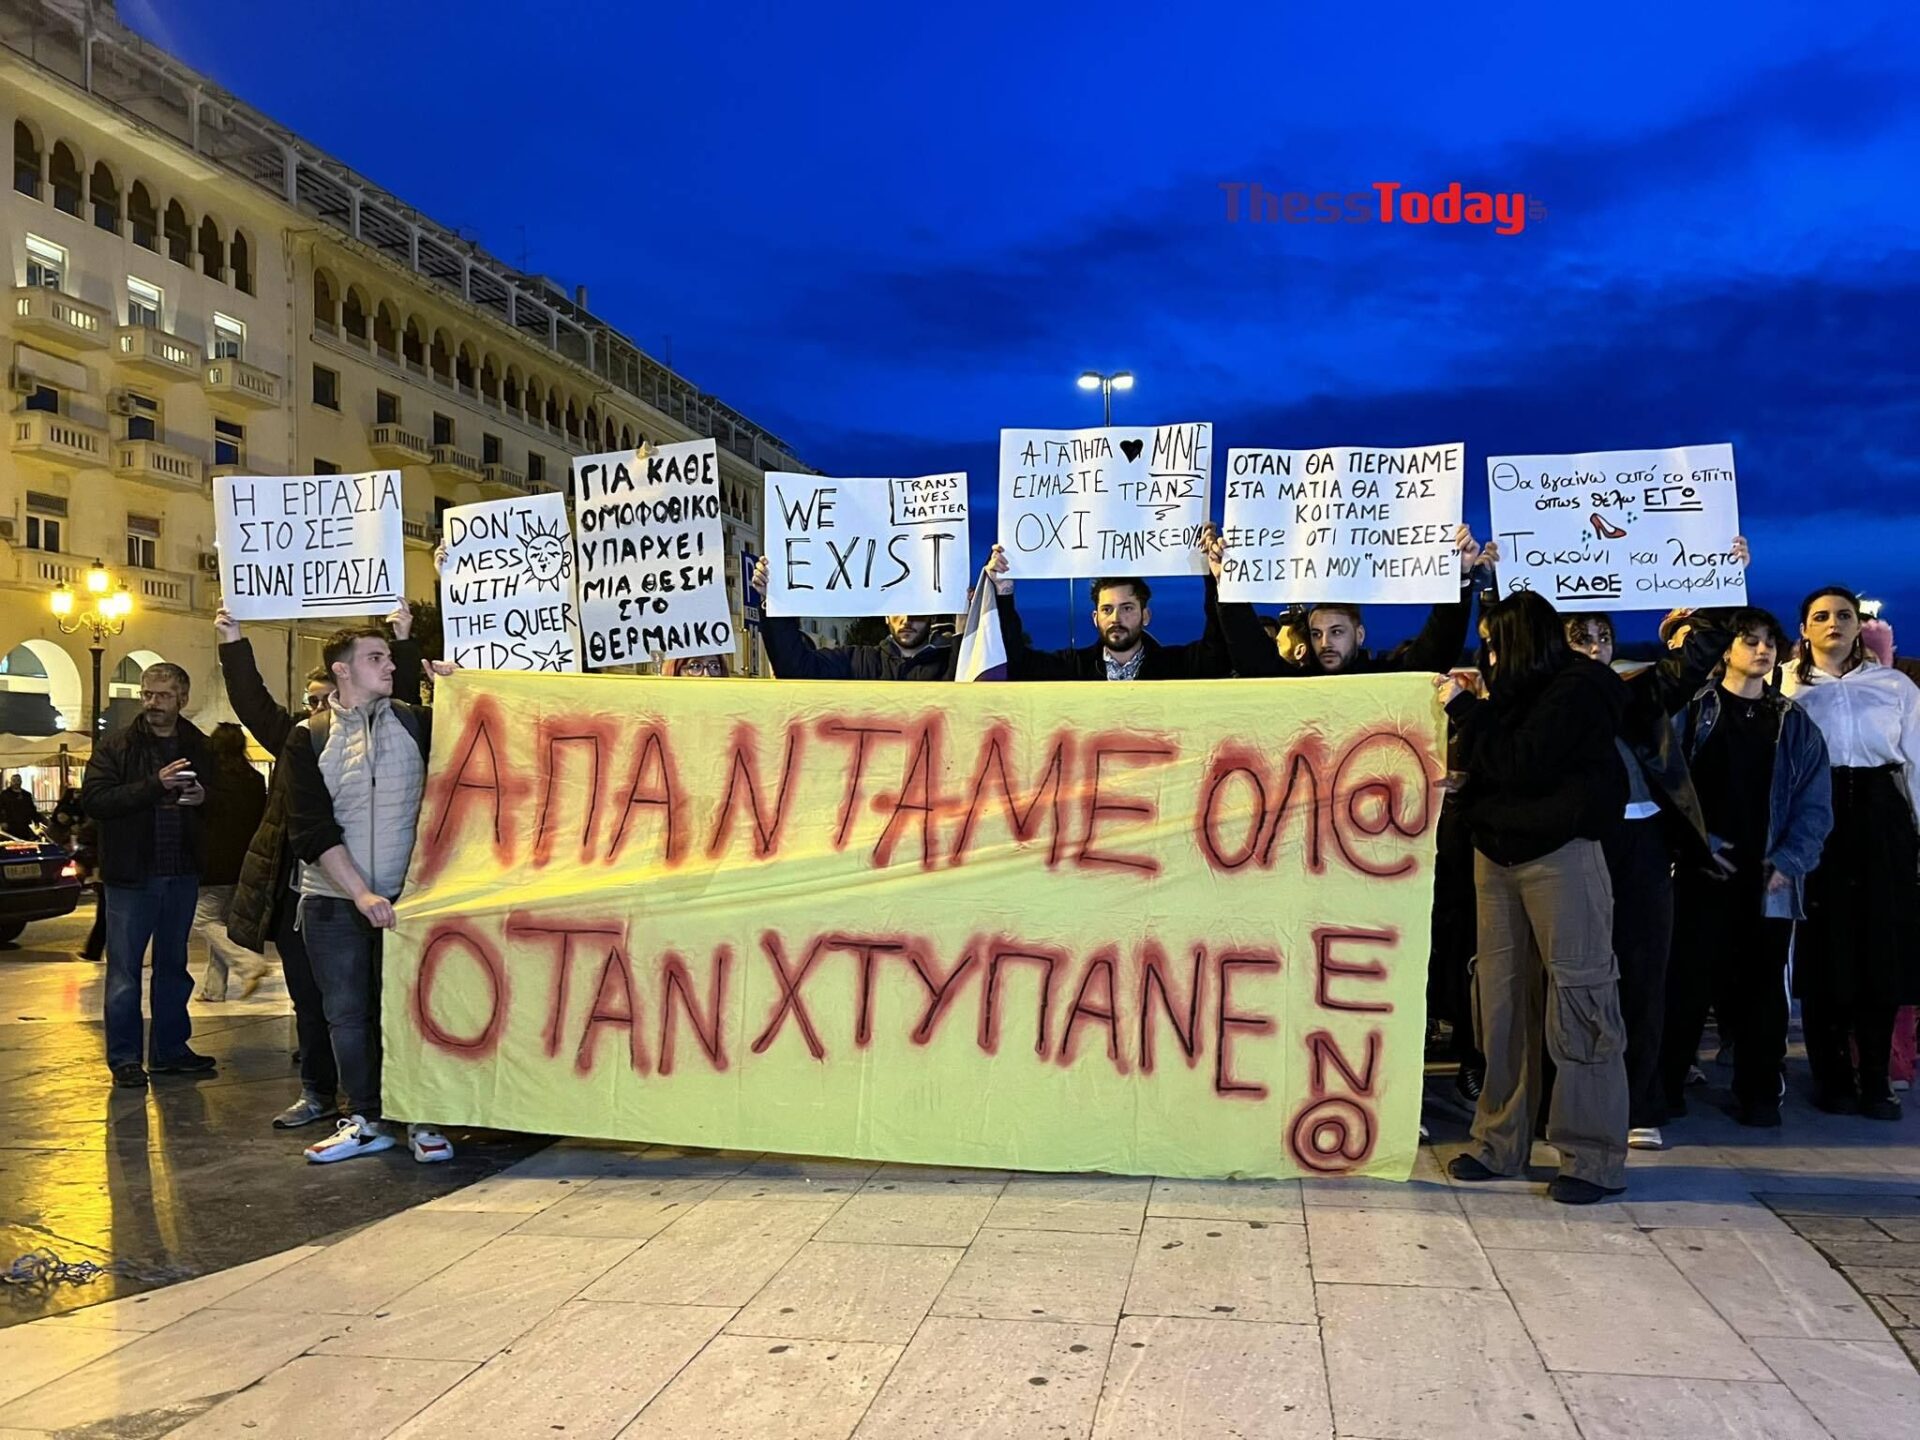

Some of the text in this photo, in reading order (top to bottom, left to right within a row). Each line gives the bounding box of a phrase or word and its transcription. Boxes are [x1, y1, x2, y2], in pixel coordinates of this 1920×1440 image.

[1151, 424, 1208, 471] ΜΜΕ
[1233, 448, 1458, 475] ΟΤΑΝ ΘΑ ΠΕΡΝΑΜΕ
[580, 452, 715, 501] ΓΙΑ ΚΑΘΕ
[896, 478, 959, 493] TRANS
[1013, 469, 1204, 502] ΕΙΜΑΣΤΕ ΤΡΑΝΣ
[1227, 479, 1436, 500] ΣΤΑ ΜΑΤΙΑ ΘΑ ΣΑΣ
[1492, 462, 1734, 493] Θα βγαίνω από το σπίτι
[232, 474, 399, 516] Η ΕΡΓΑΣΙΑ
[775, 485, 837, 532] WE
[903, 491, 950, 504] LIVES
[903, 503, 966, 518] MATTER
[1535, 494, 1581, 511] όπως
[1591, 489, 1636, 511] θέλω
[450, 507, 533, 547] DON'T
[581, 495, 720, 532] ΟΜΟΦΟΒΙΚΟ
[1295, 502, 1390, 524] ΚΟΙΤΑΜΕ
[240, 517, 353, 552] ΣΤΟ ΣΕΞ
[1015, 511, 1091, 552] ΟΧΙ
[1226, 524, 1456, 549] ΞΕΡΩ ΟΤΙ ΠΟΝΕΣΕΣ
[1498, 531, 1610, 567] Τακούνι
[1629, 550, 1658, 565] και
[456, 548, 523, 575] MESS
[582, 531, 704, 572] ΥΠΑΡΧΕΙ
[785, 533, 955, 593] EXIST
[233, 558, 391, 596] ΕΙΝΑΙ ΕΡΓΑΣΙΑ
[584, 566, 714, 602] ΜΙΑ ΘΕΣΗ
[1223, 558, 1317, 583] ΦΑΣΙΣΤΑ
[1326, 556, 1361, 578] ΜΟΥ
[1556, 573, 1622, 593] ΚΑΘΕ
[1636, 568, 1745, 593] ομοφοβικό
[450, 574, 520, 605] WITH
[448, 602, 577, 640] THE QUEER
[618, 596, 669, 621] ΣΤΟ
[454, 641, 534, 670] KIDS
[589, 621, 730, 662] ΘΕΡΜΑΙΚΟ
[417, 694, 1178, 884] ΑΠΑΝΤΑΜΕ
[413, 912, 730, 1076] ΟΤΑΝ
